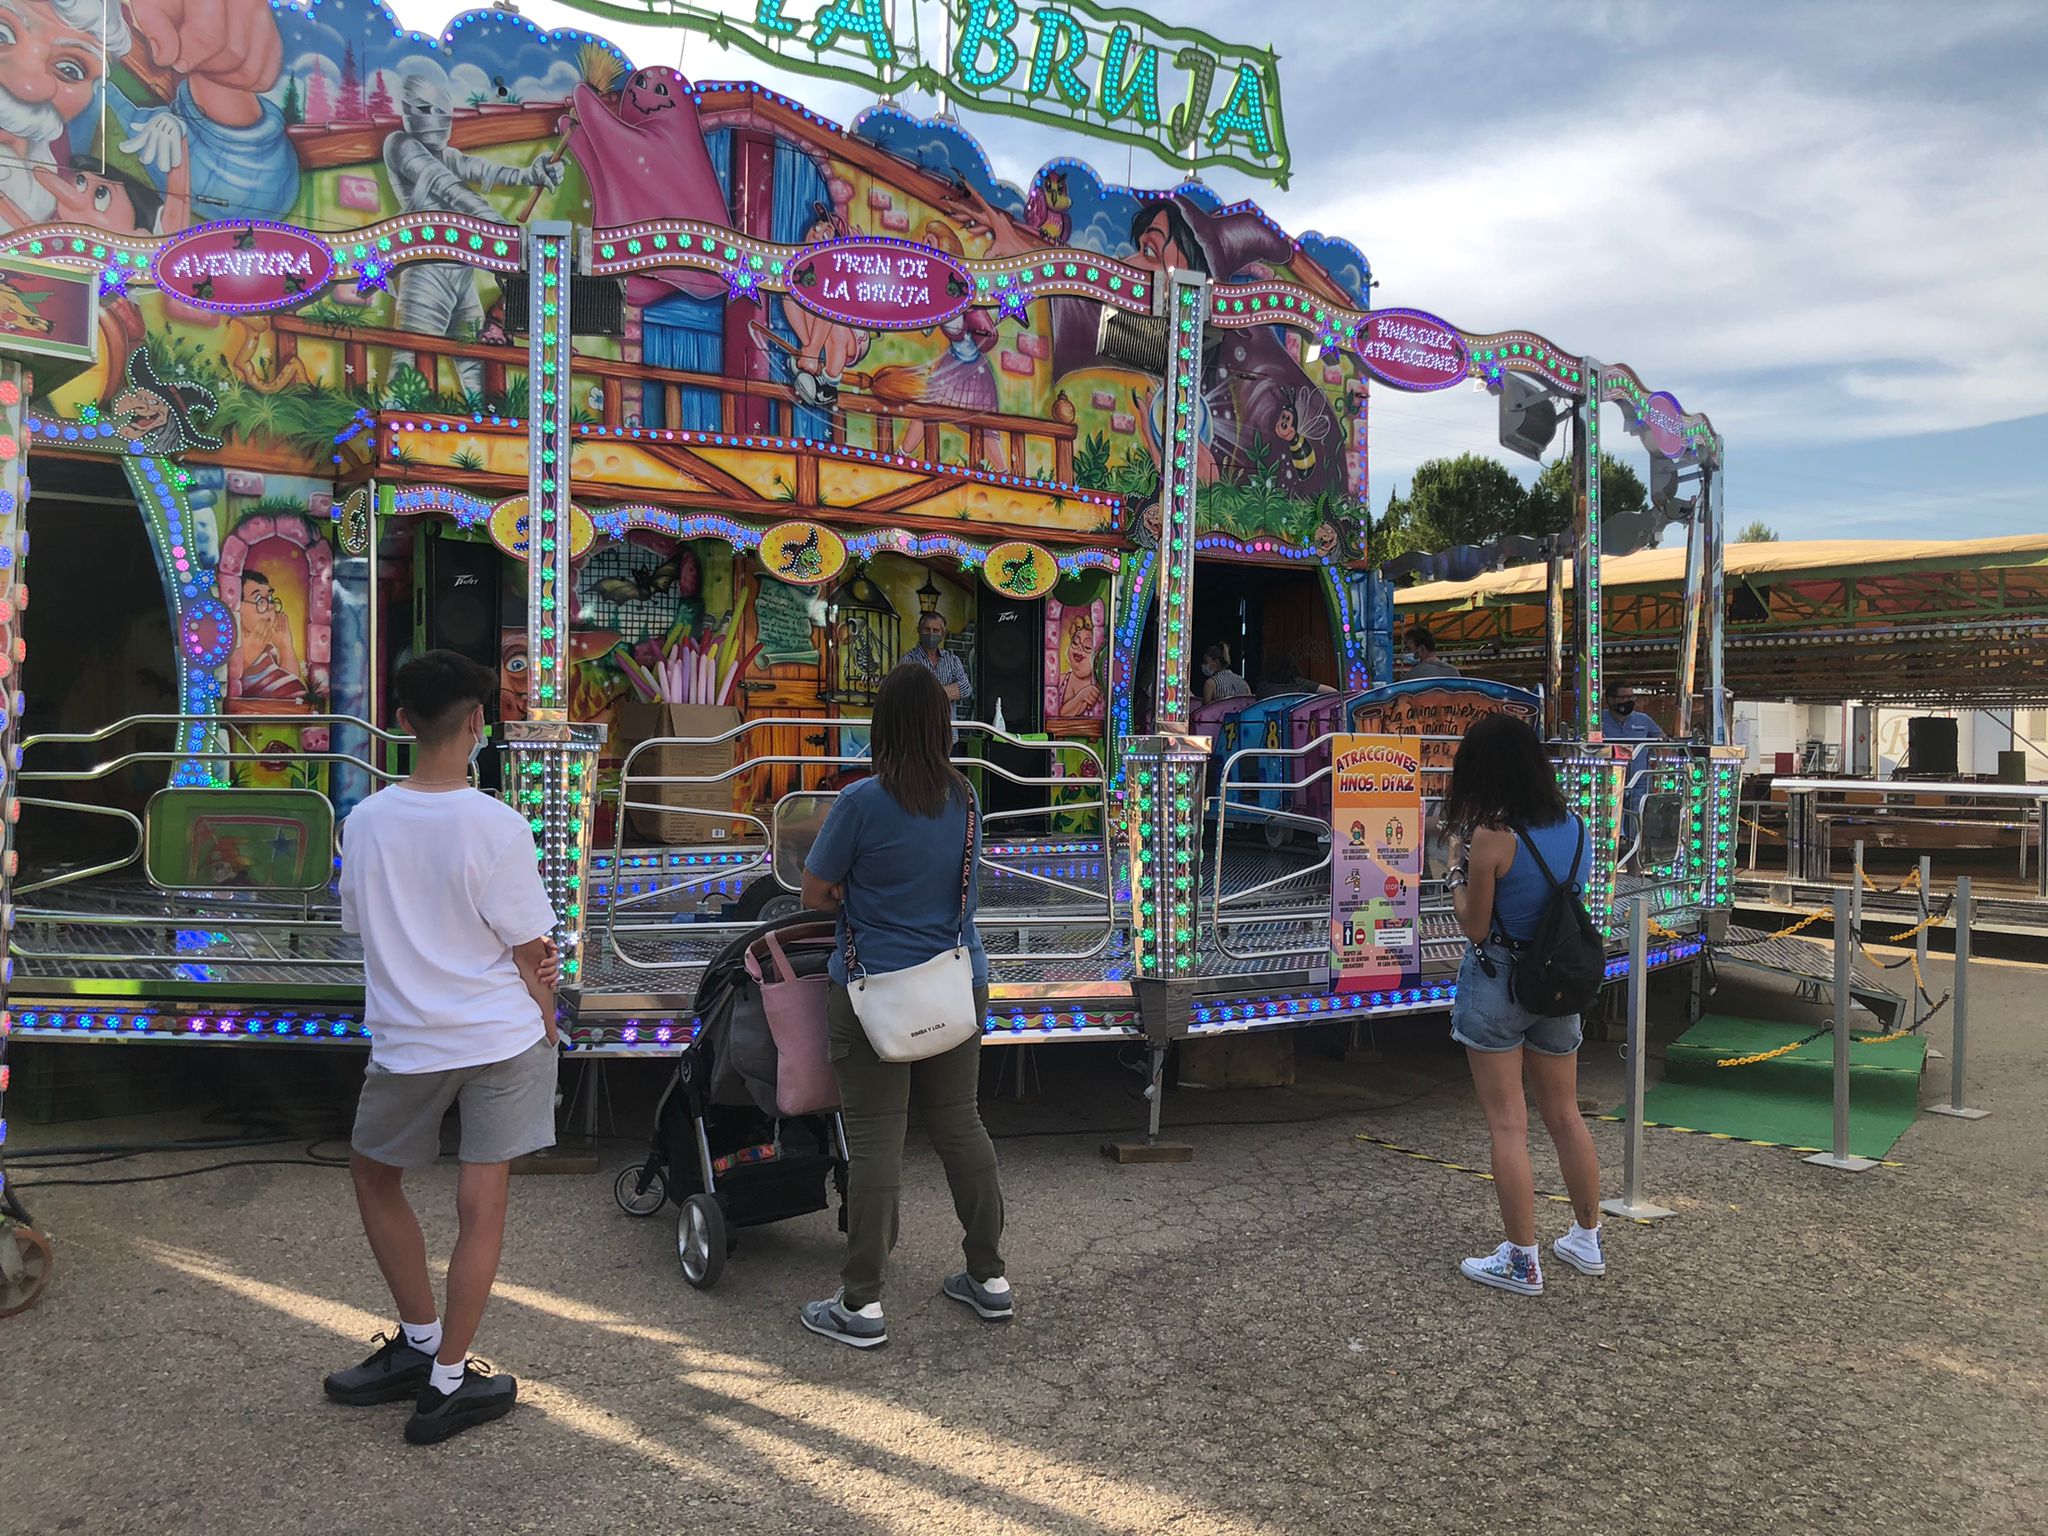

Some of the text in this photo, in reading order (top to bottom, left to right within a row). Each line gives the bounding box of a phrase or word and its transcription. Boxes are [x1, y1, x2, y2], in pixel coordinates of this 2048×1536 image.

[953, 0, 1273, 157] BRUJA
[172, 251, 313, 278] AVENTURA
[832, 252, 929, 279] TREN DE
[822, 278, 930, 308] LA BRUJA
[1224, 722, 1236, 751] 7
[1266, 720, 1279, 750] 8
[1336, 746, 1419, 774] ATRACCIONES
[1339, 774, 1379, 793] HNOS.
[932, 1022, 946, 1031] LOLA
